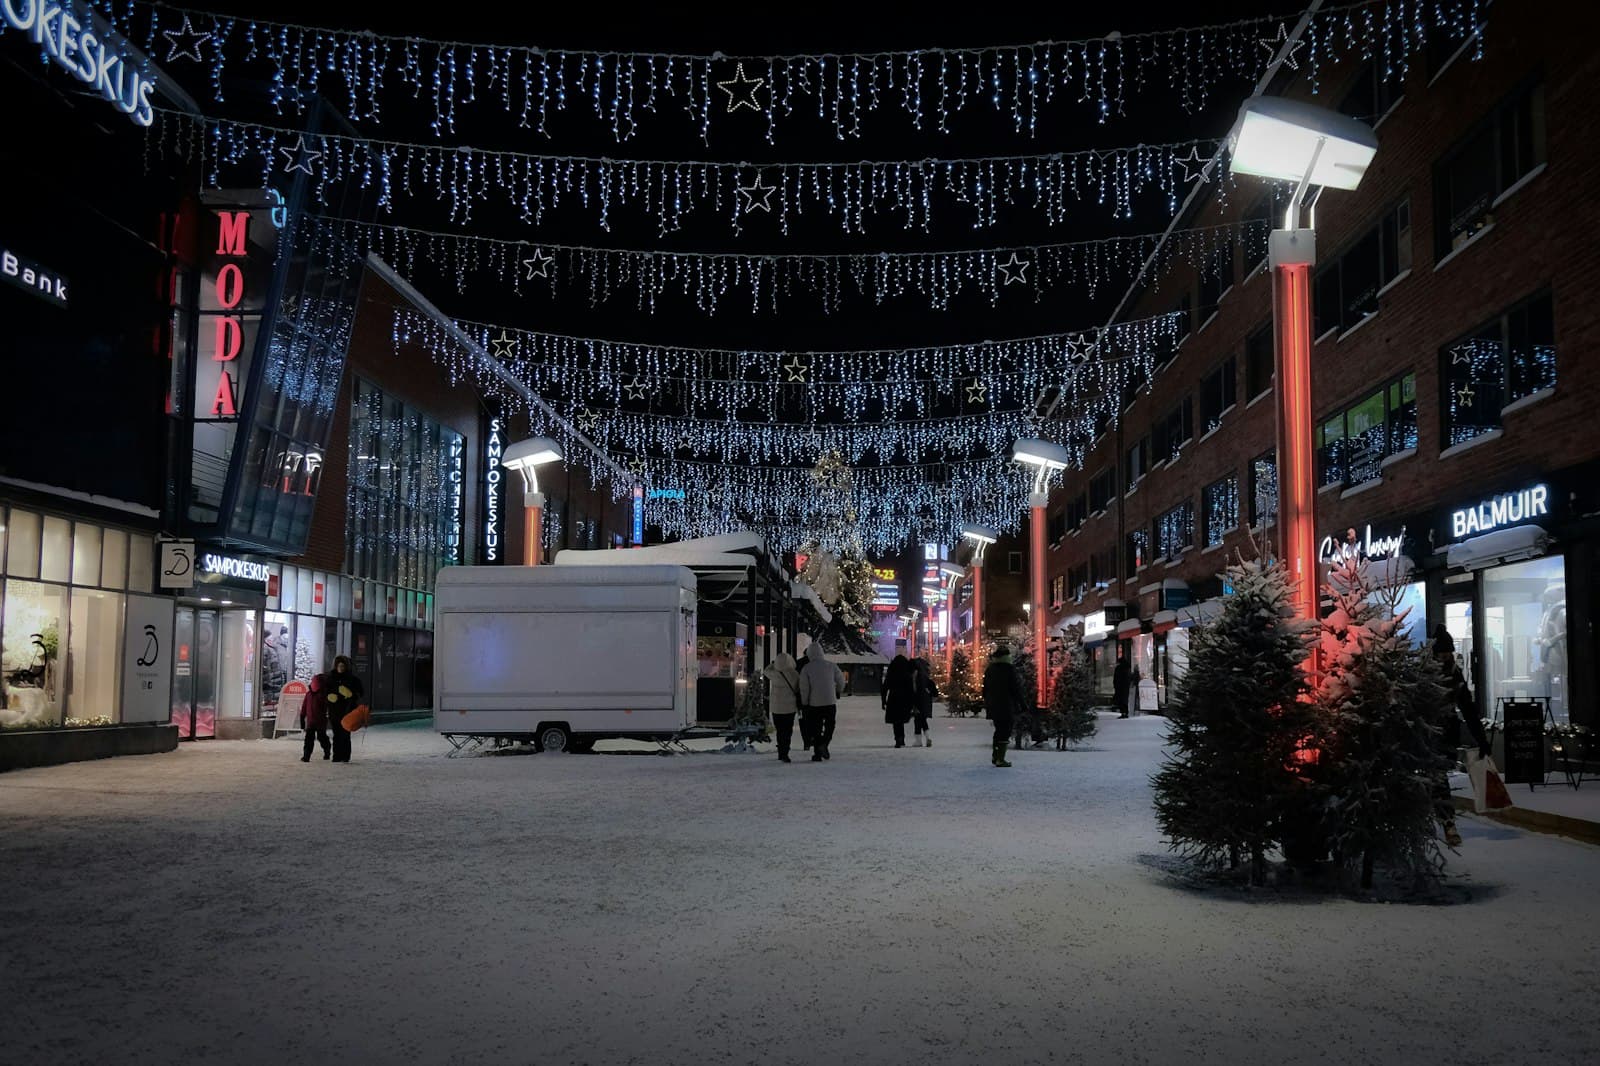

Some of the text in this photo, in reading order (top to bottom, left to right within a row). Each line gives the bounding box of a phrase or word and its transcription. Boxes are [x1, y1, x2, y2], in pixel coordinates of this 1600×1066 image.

[2, 250, 67, 301] Bank
[212, 211, 250, 416] MODA
[486, 418, 501, 561] SAMPOKESKUS
[1452, 484, 1548, 538] BALMUIR
[206, 554, 270, 582] SAMPOKESKUS
